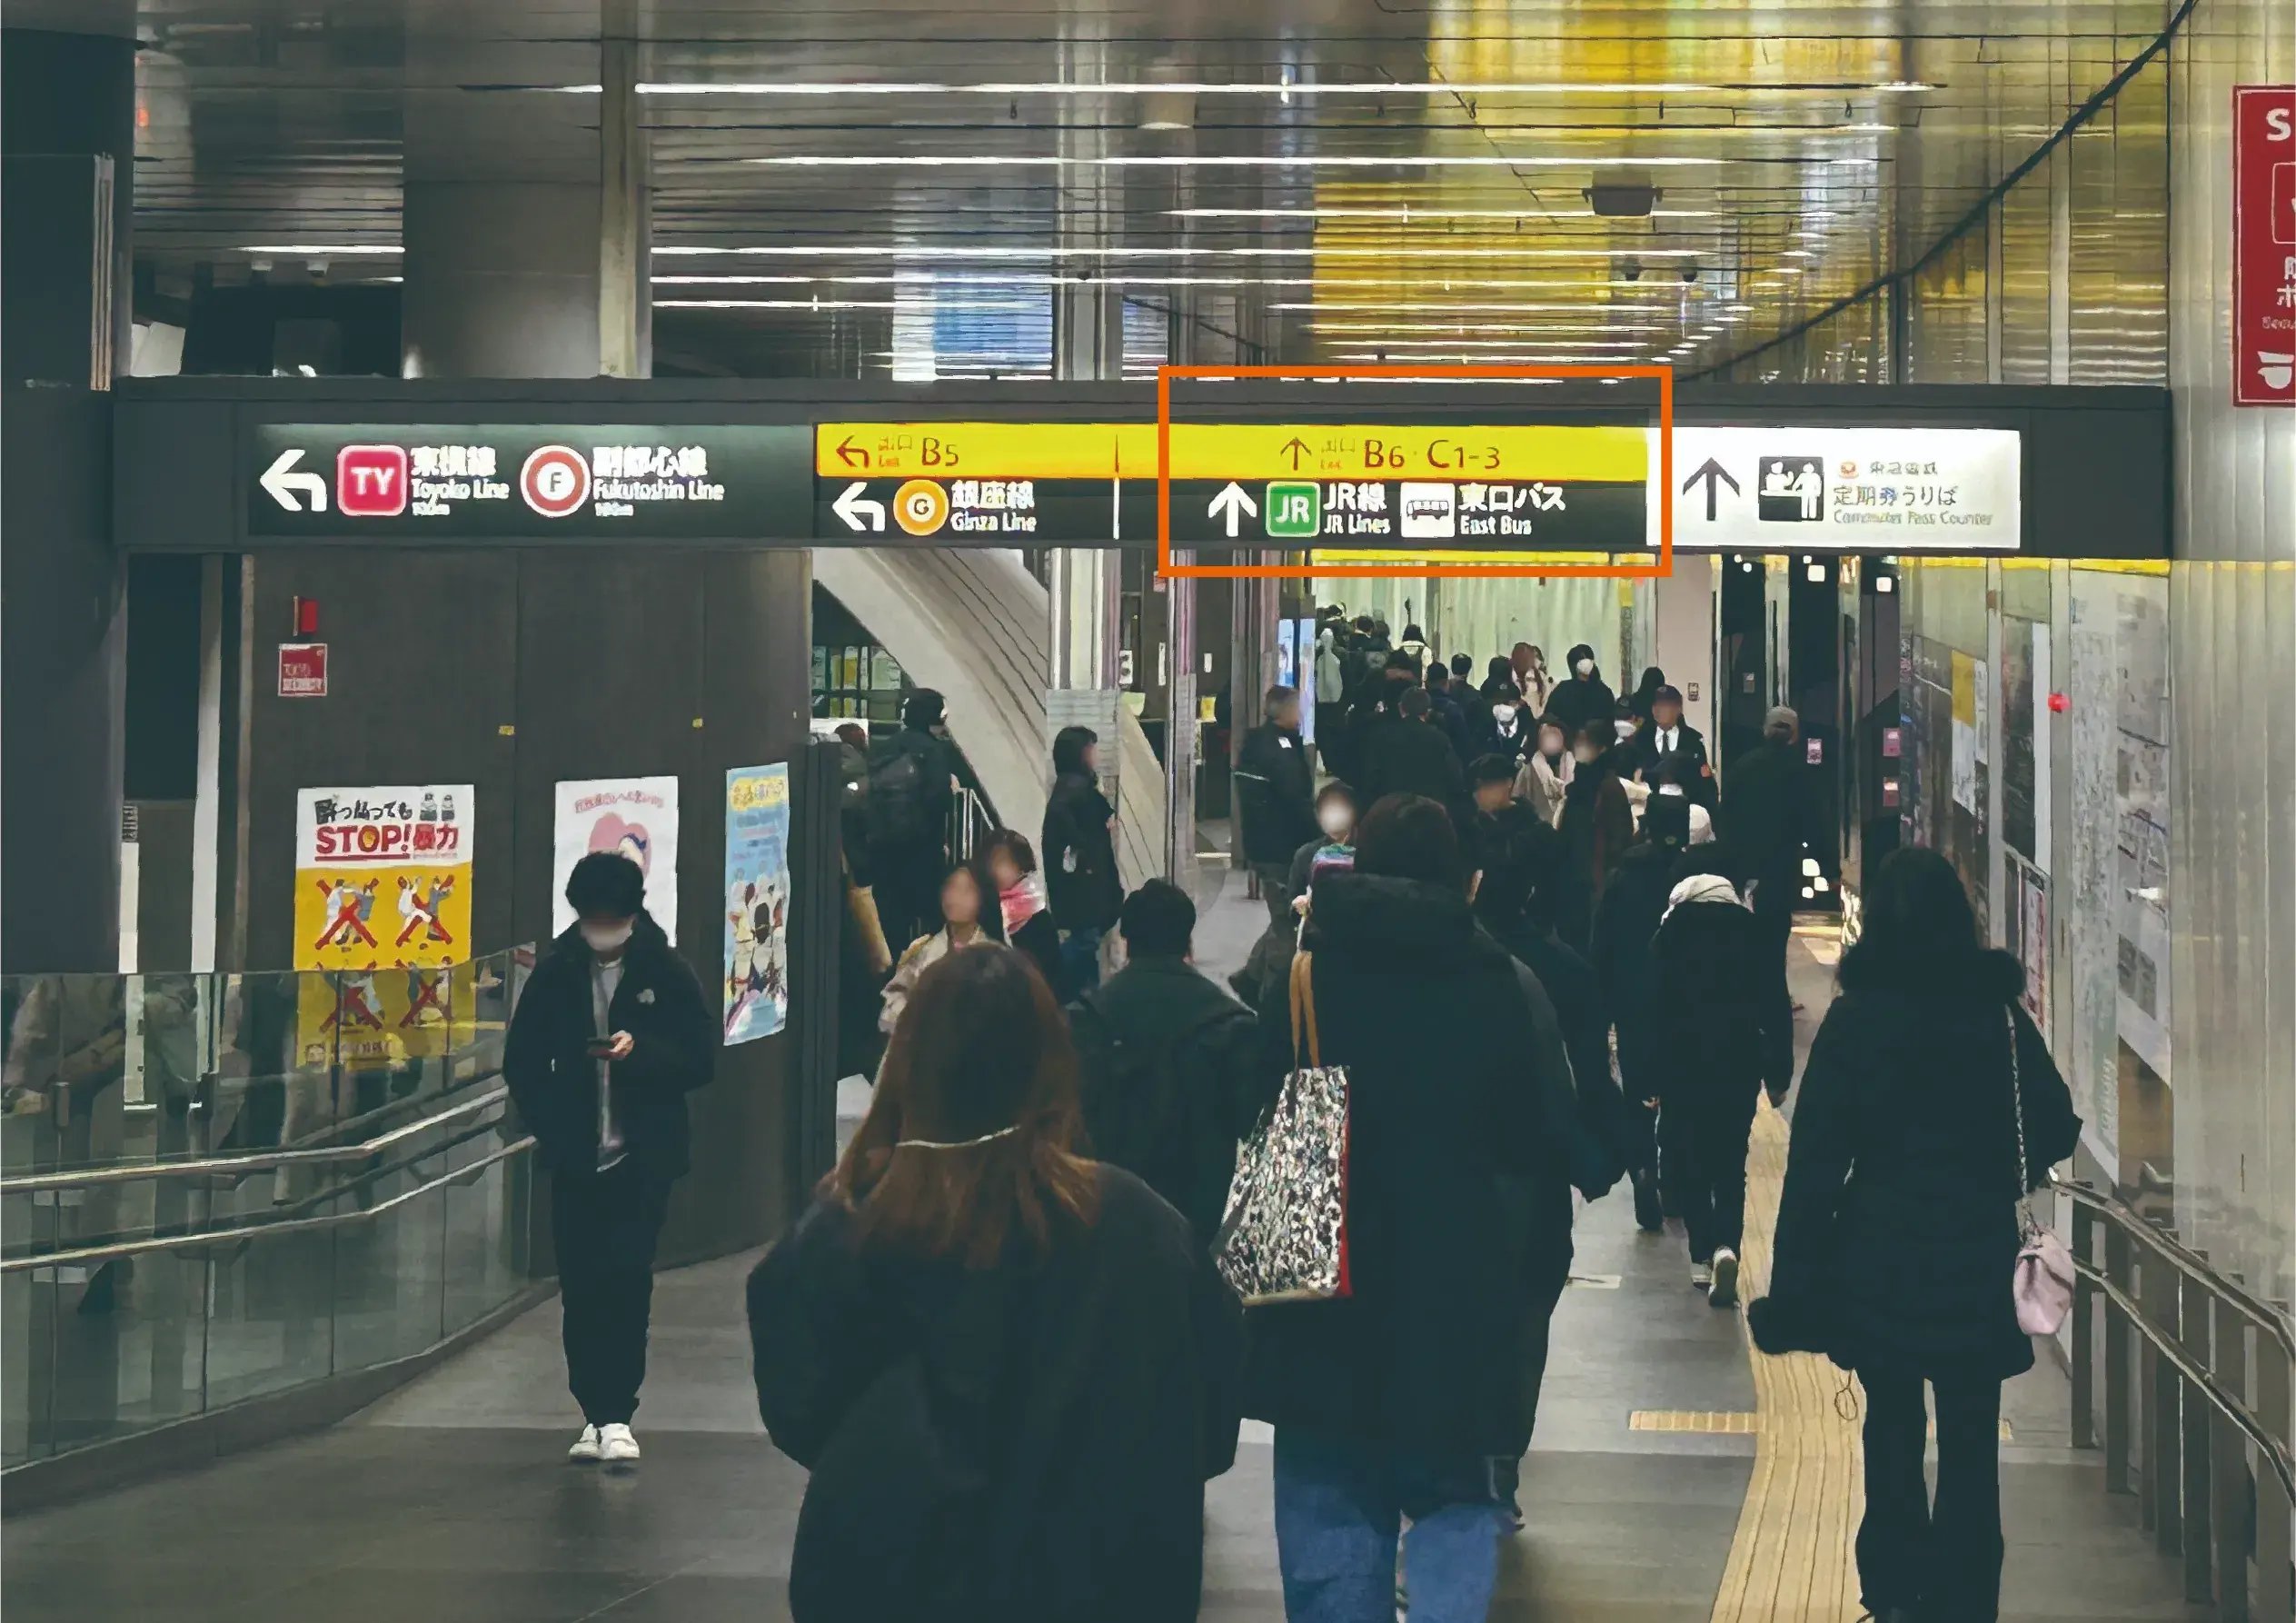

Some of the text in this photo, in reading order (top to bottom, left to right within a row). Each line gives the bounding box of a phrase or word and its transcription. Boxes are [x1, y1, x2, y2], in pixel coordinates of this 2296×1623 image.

[922, 437, 959, 466] B5
[1365, 440, 1500, 469] B6 C1-3
[351, 466, 394, 496] TY
[473, 478, 510, 499] Line
[550, 472, 562, 493] F
[593, 478, 725, 500] Fukutoshin Line
[913, 498, 929, 515] G
[1323, 483, 1387, 512] JR線
[1458, 483, 1566, 512] 東口バス
[1275, 495, 1310, 523] JR
[1908, 511, 1936, 524] Pass
[950, 511, 1037, 532] Ginza Line
[1324, 513, 1391, 534] JR Lines
[1460, 514, 1532, 535] East Bus
